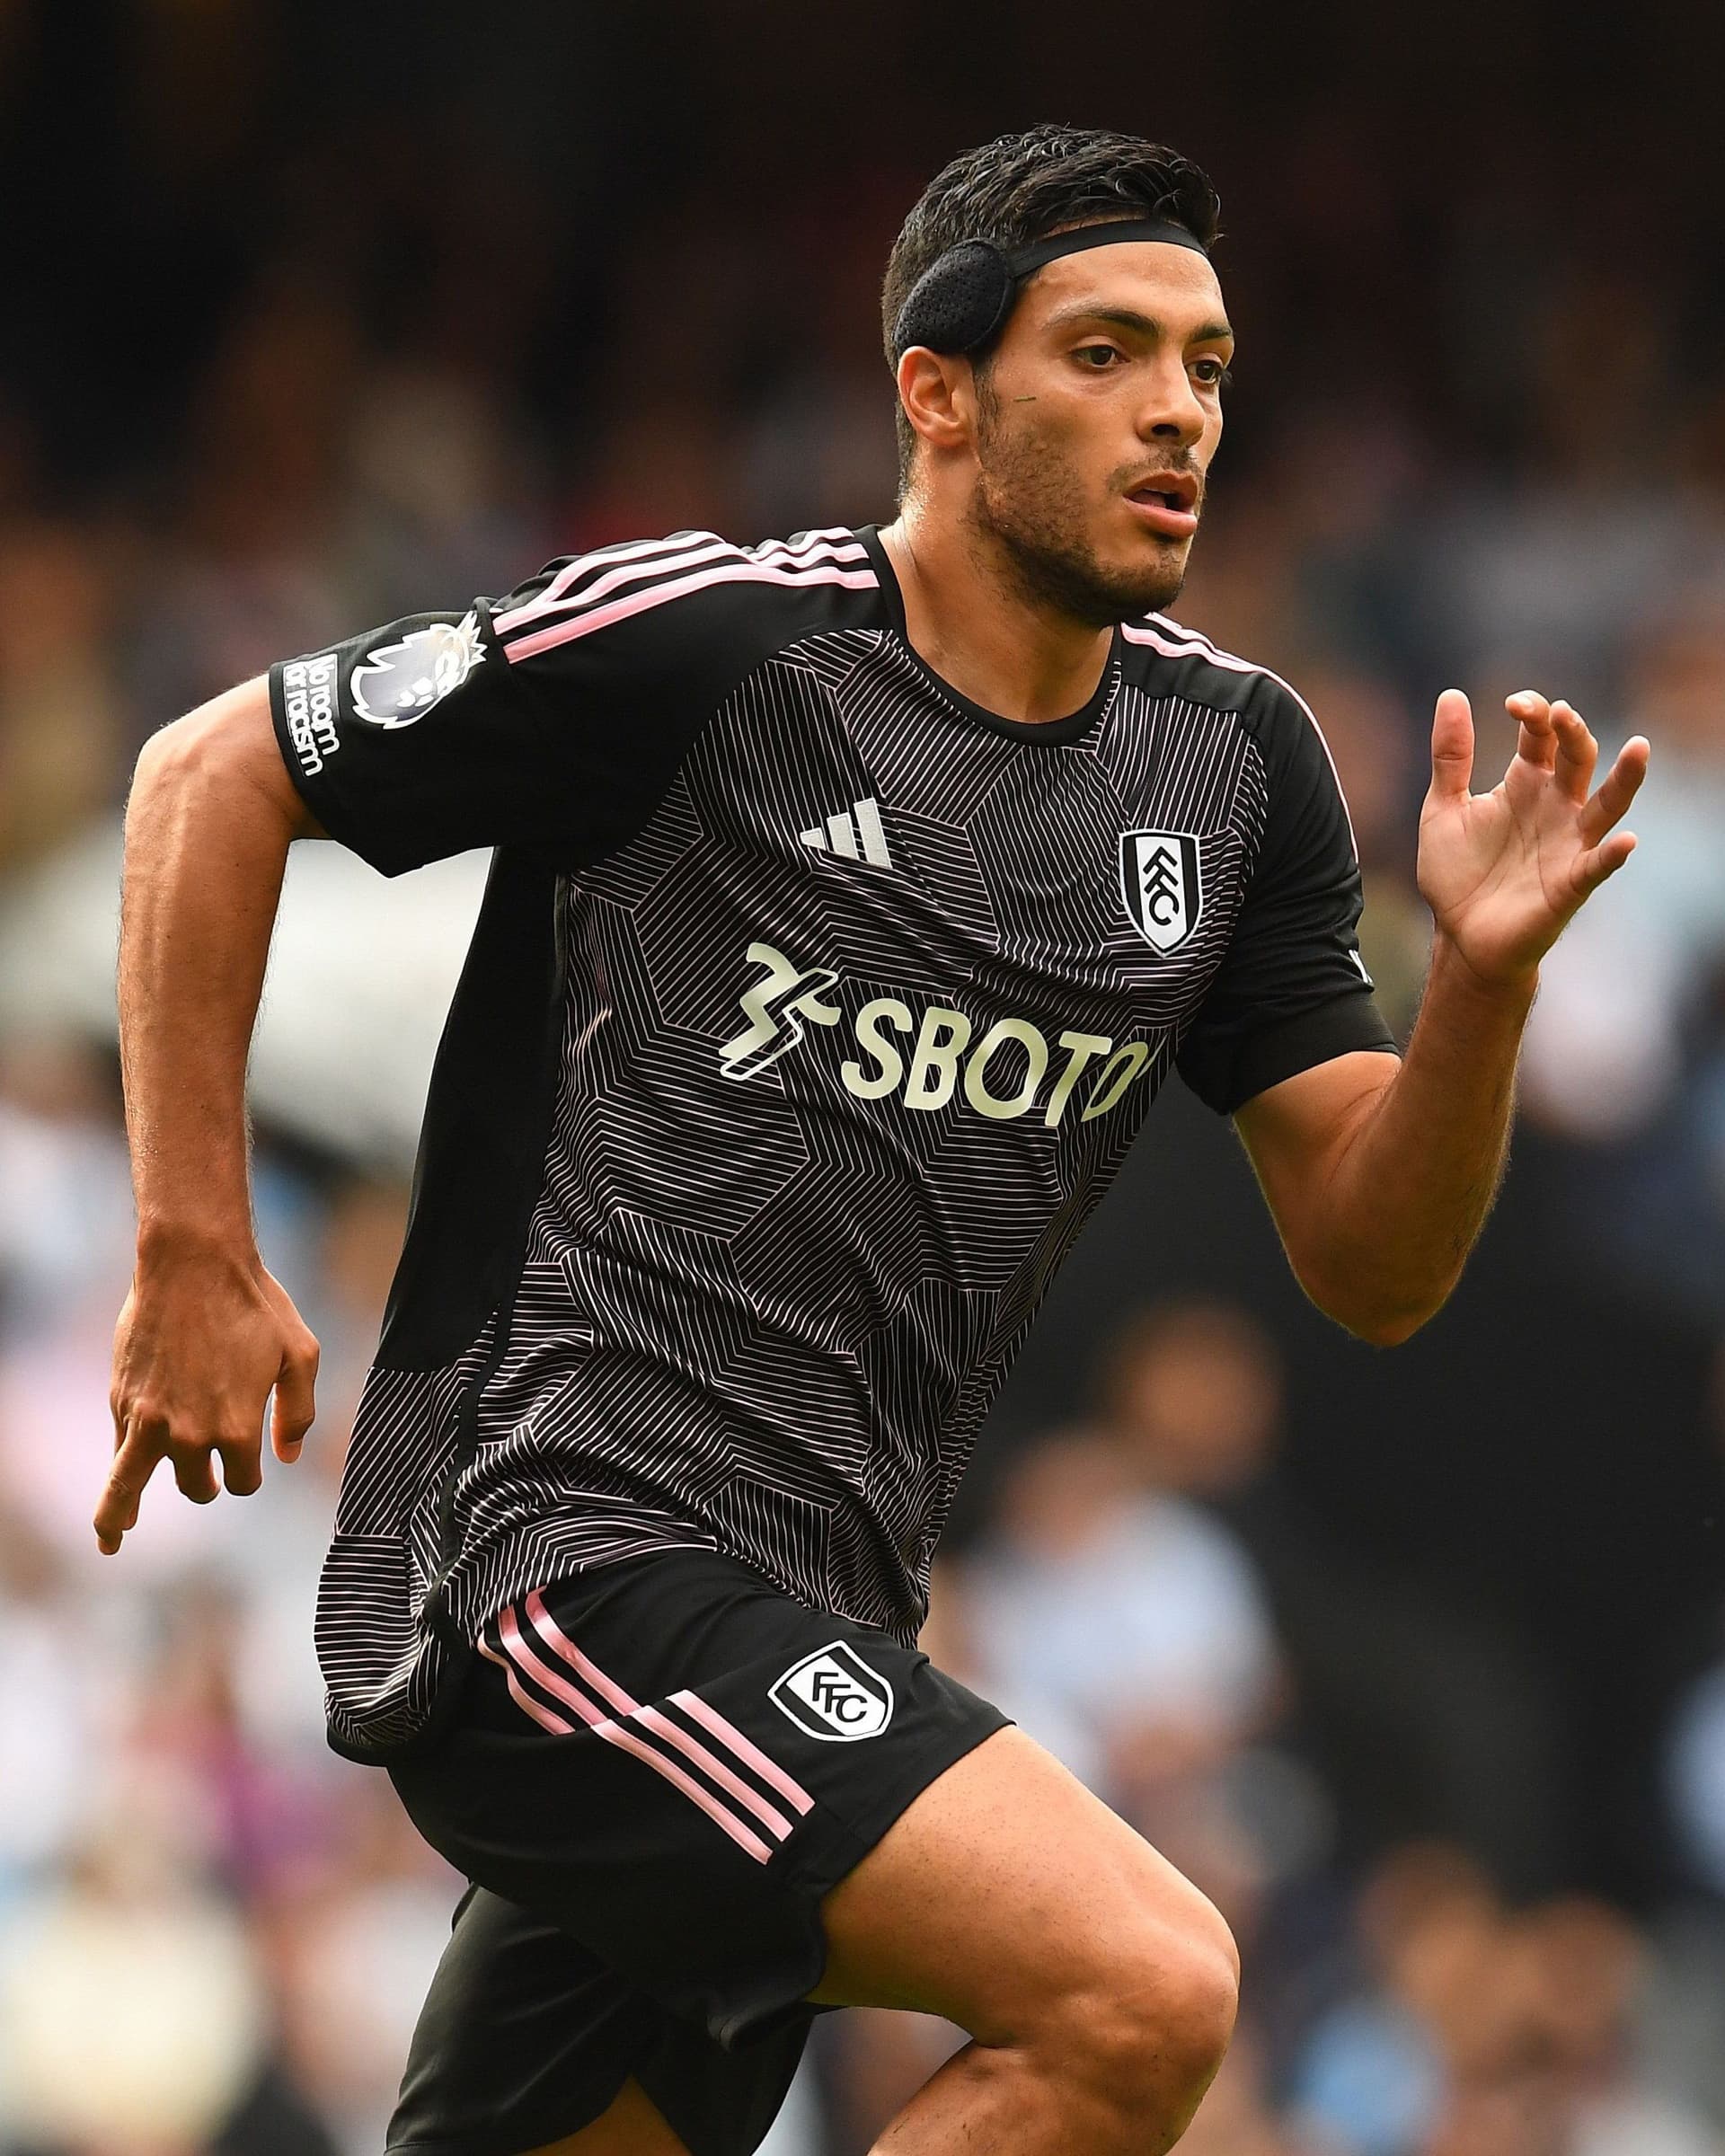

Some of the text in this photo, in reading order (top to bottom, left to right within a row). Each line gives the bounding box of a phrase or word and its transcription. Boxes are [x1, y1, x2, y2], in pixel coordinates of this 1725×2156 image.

[286, 689, 323, 777] racism
[309, 685, 341, 755] room
[1142, 845, 1180, 926] FFC
[841, 997, 1167, 1127] SBOTO
[812, 1671, 868, 1724] FFC
